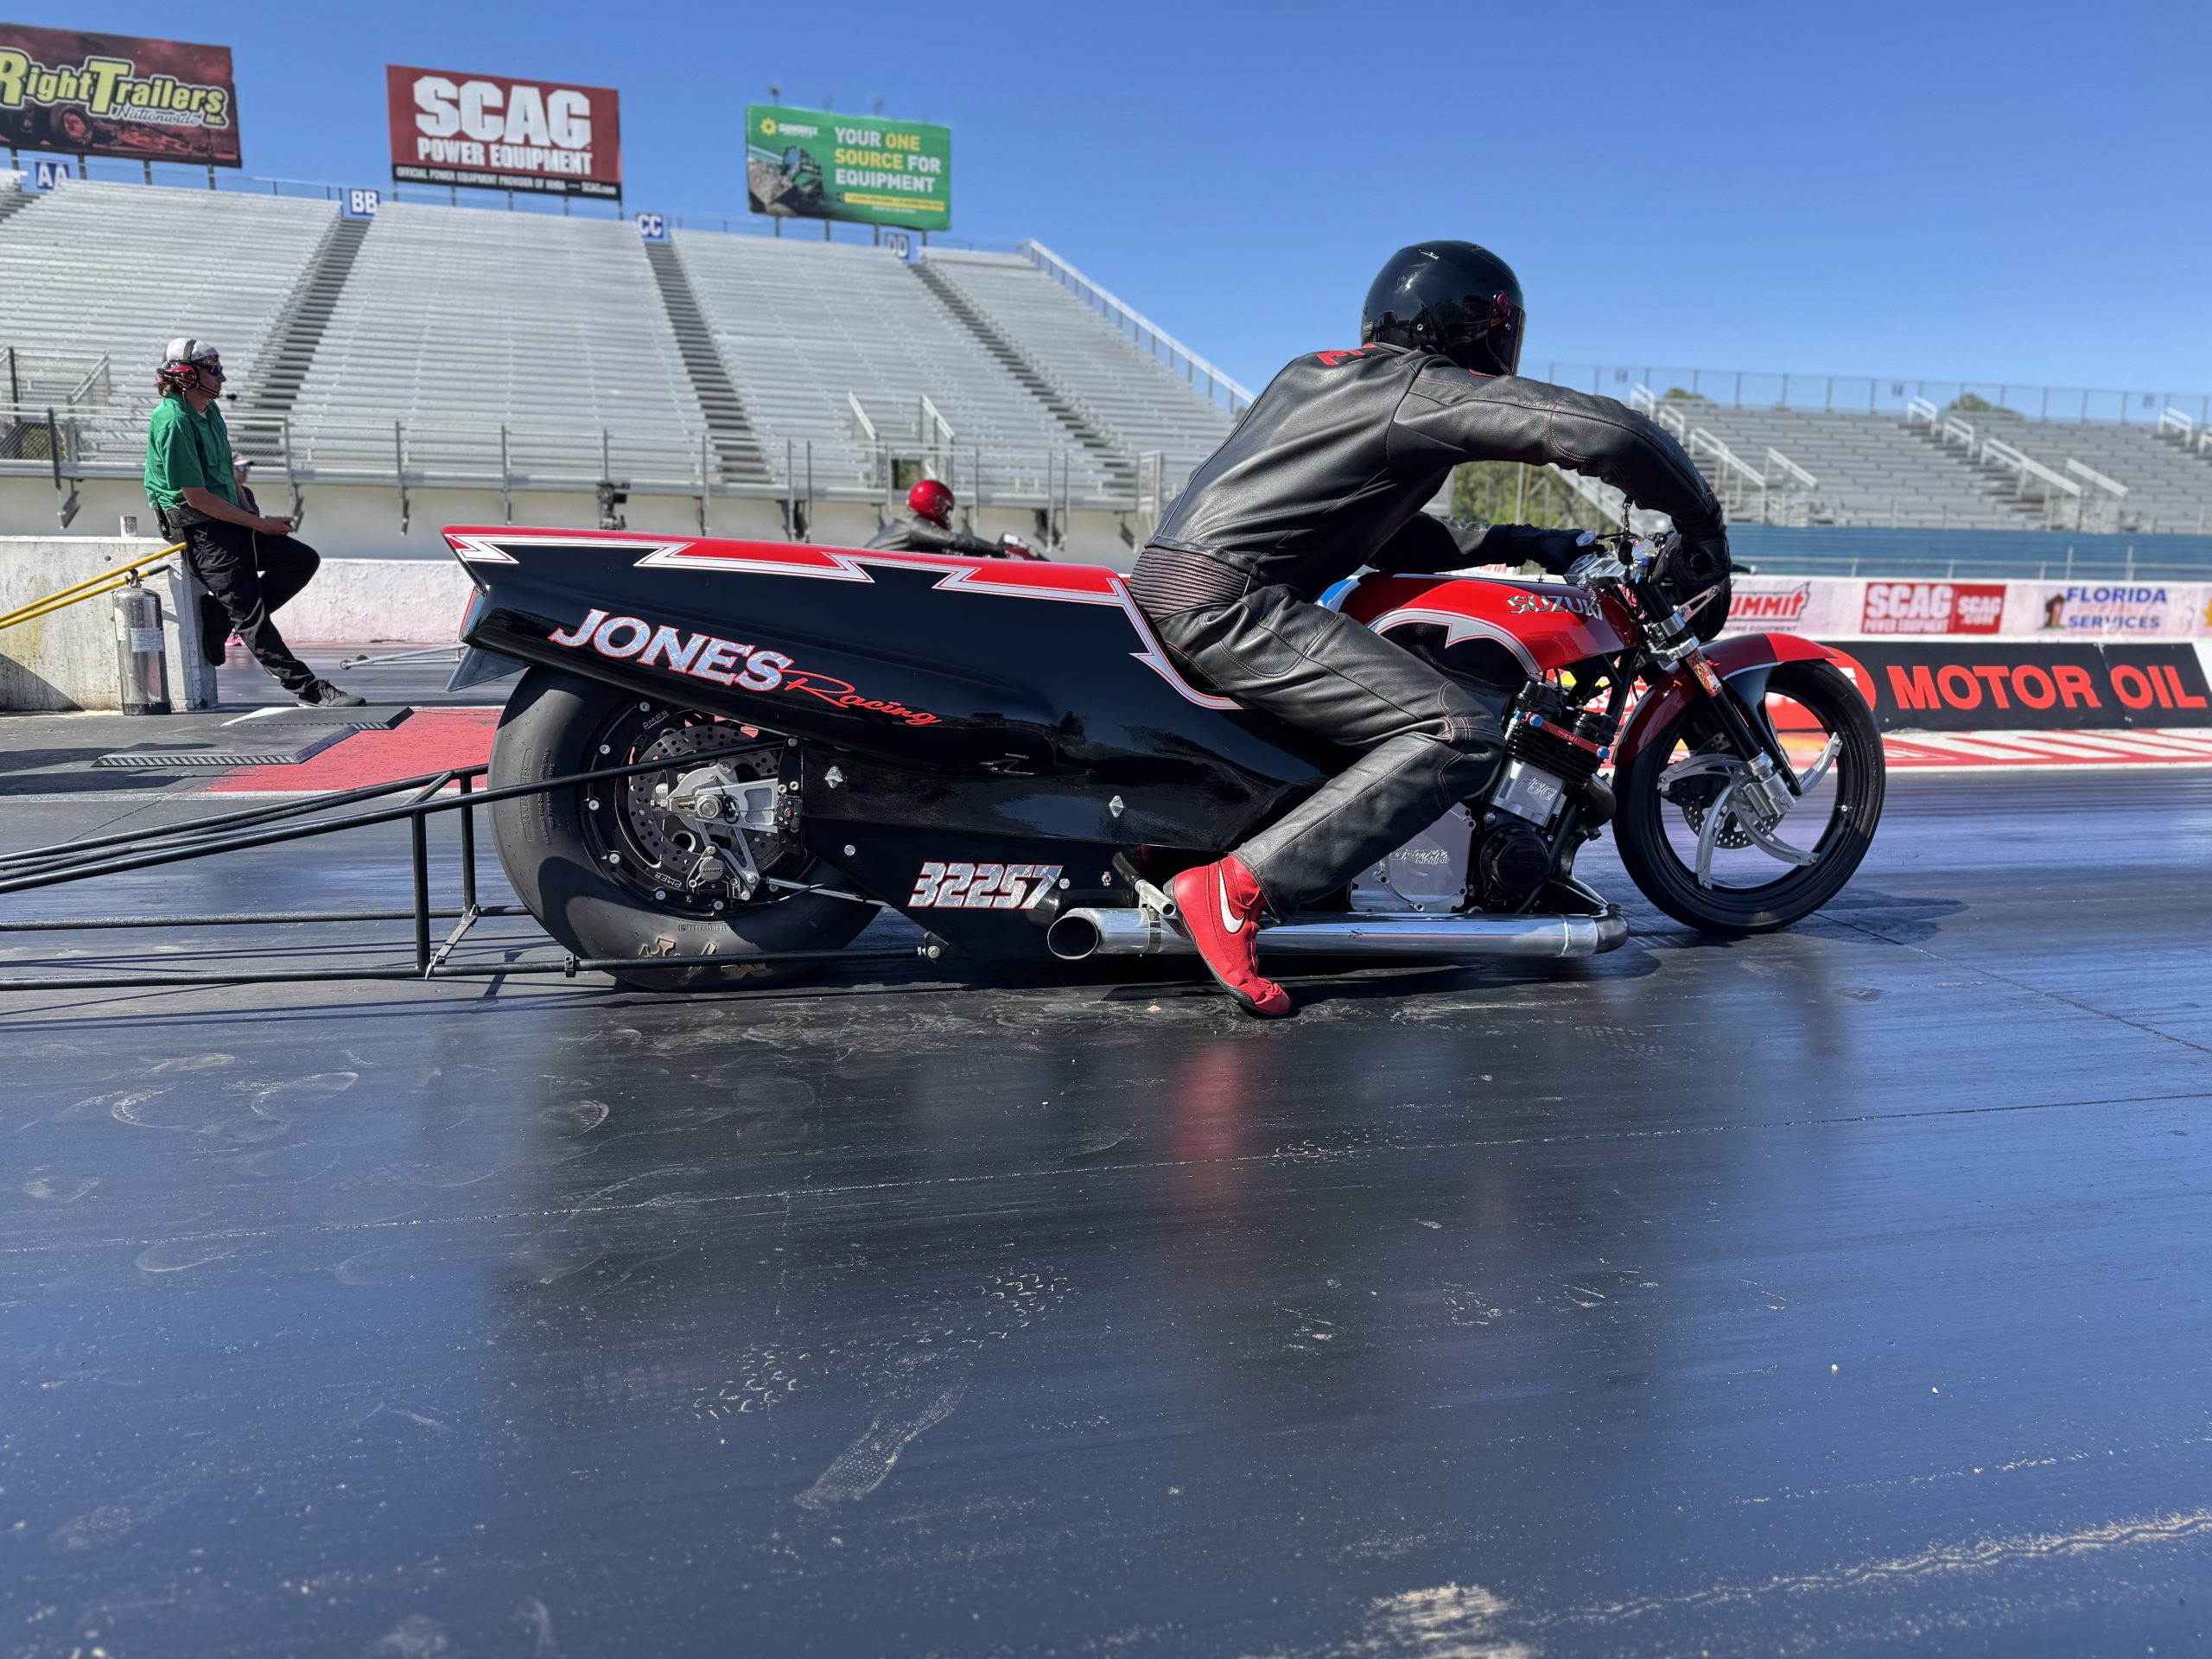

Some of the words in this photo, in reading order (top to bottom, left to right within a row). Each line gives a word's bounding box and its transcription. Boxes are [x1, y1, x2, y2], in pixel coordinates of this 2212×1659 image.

[413, 75, 593, 150] SCAG
[835, 127, 881, 147] YOUR
[885, 132, 921, 151] ONE
[417, 137, 486, 166] POWER
[490, 143, 593, 175] EQUIPMENT
[835, 149, 904, 169] SOURCE
[907, 155, 942, 174] FOR
[37, 162, 68, 188] AA
[429, 168, 456, 182] POWER
[456, 171, 498, 185] EQUIPMENT
[835, 168, 936, 193] EQUIPMENT
[351, 190, 378, 214] BB
[637, 215, 663, 237] CC
[1507, 594, 1604, 621] SUZUKI
[1729, 590, 1804, 617] UMMIT
[1866, 583, 1954, 620] SCAG
[1957, 595, 2003, 616] SCAG
[2066, 587, 2167, 604] FLORIDA
[2069, 615, 2160, 629] SERVICES
[548, 607, 794, 692] JONES
[778, 668, 942, 727] Racing
[1886, 664, 2101, 710] MOTOR
[2110, 664, 2208, 710] OIL
[907, 861, 1065, 910] 32257
